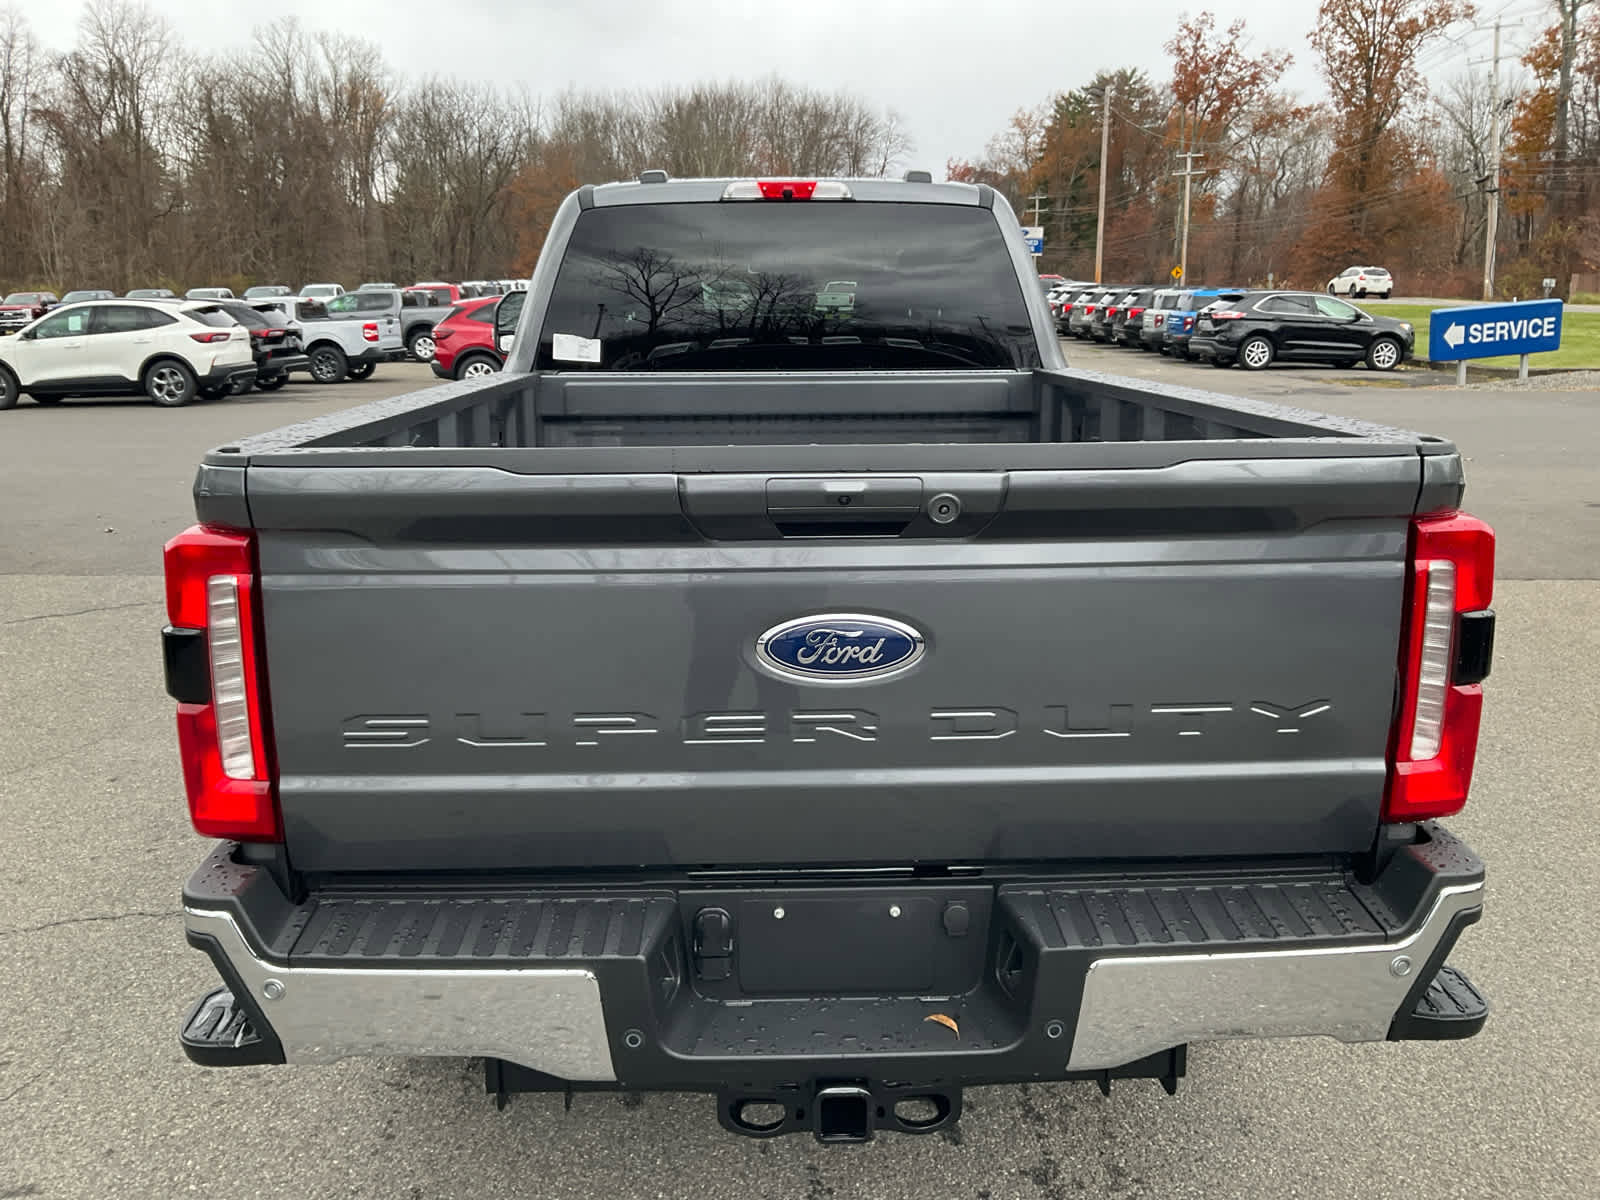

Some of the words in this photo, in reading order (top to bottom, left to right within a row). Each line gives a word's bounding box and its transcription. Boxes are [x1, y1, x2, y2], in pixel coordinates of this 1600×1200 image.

[1468, 317, 1556, 343] SERVICE
[797, 628, 886, 664] Ford
[342, 708, 880, 749] SUPER
[929, 698, 1332, 741] DUTY
